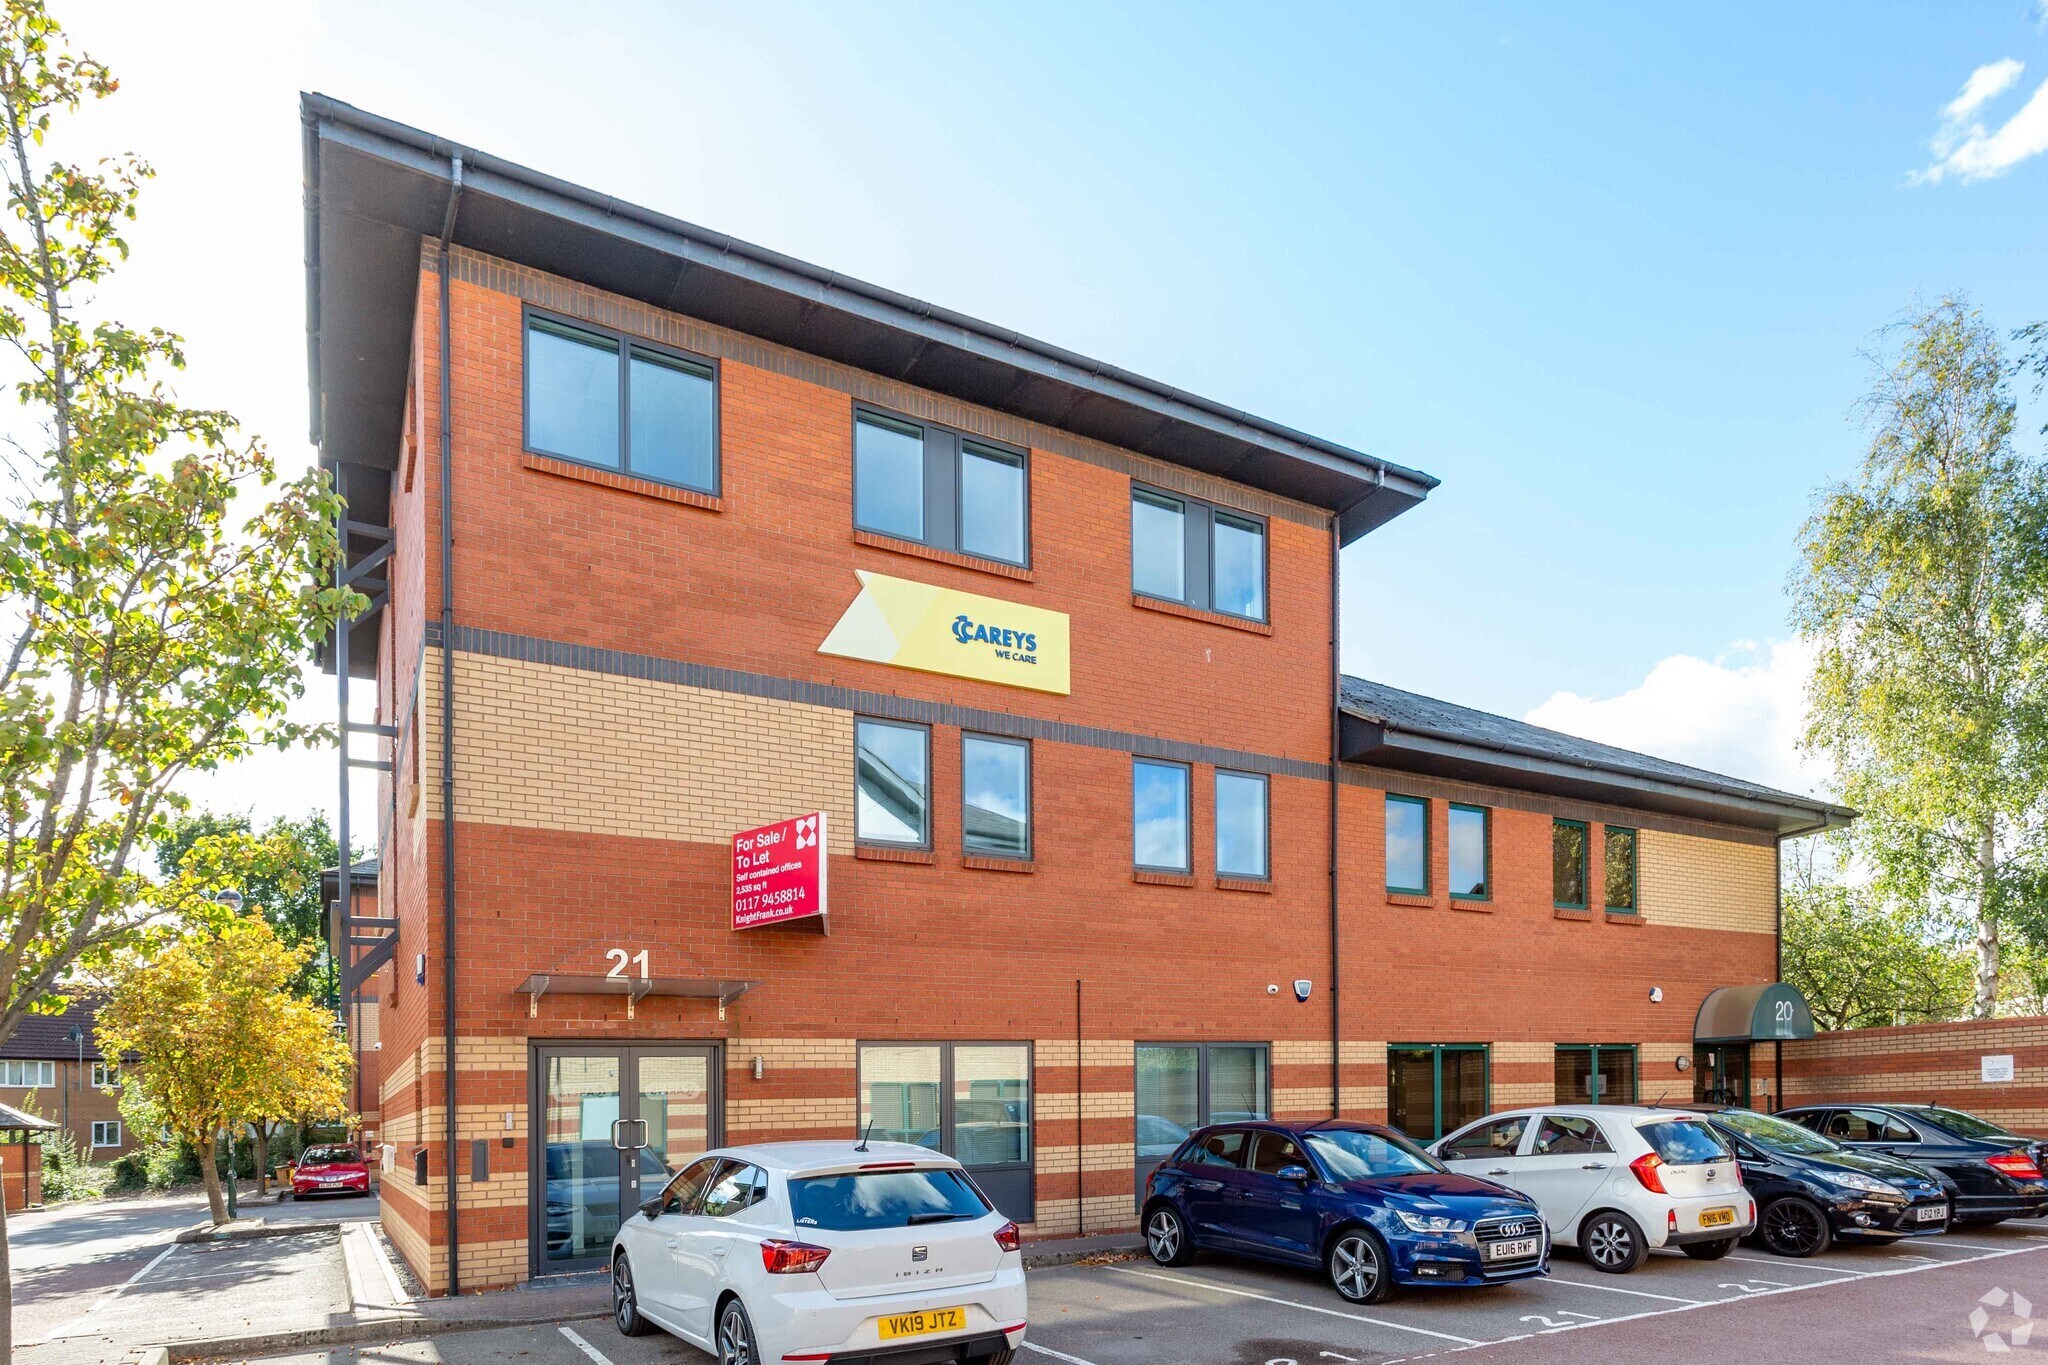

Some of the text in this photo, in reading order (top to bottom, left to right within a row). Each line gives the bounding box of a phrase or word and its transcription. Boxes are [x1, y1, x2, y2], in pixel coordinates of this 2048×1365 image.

[995, 649, 1037, 665] WE CARE
[736, 838, 755, 853] For
[756, 831, 780, 848] Sale
[736, 850, 770, 870] To Let
[736, 861, 802, 882] Self contained offices
[736, 881, 767, 895] 2,535 sq ft
[735, 886, 805, 912] 0117 9458814
[735, 904, 793, 925] KnightFrank.co.uk
[605, 948, 649, 983] 21
[1775, 1000, 1793, 1021] 20
[1496, 1240, 1532, 1256] EU16 RWF
[895, 1267, 943, 1278] IBIZA
[1716, 1278, 1793, 1293] 21
[889, 1310, 957, 1334] VK19 JTZ
[1518, 1309, 1602, 1328] 21
